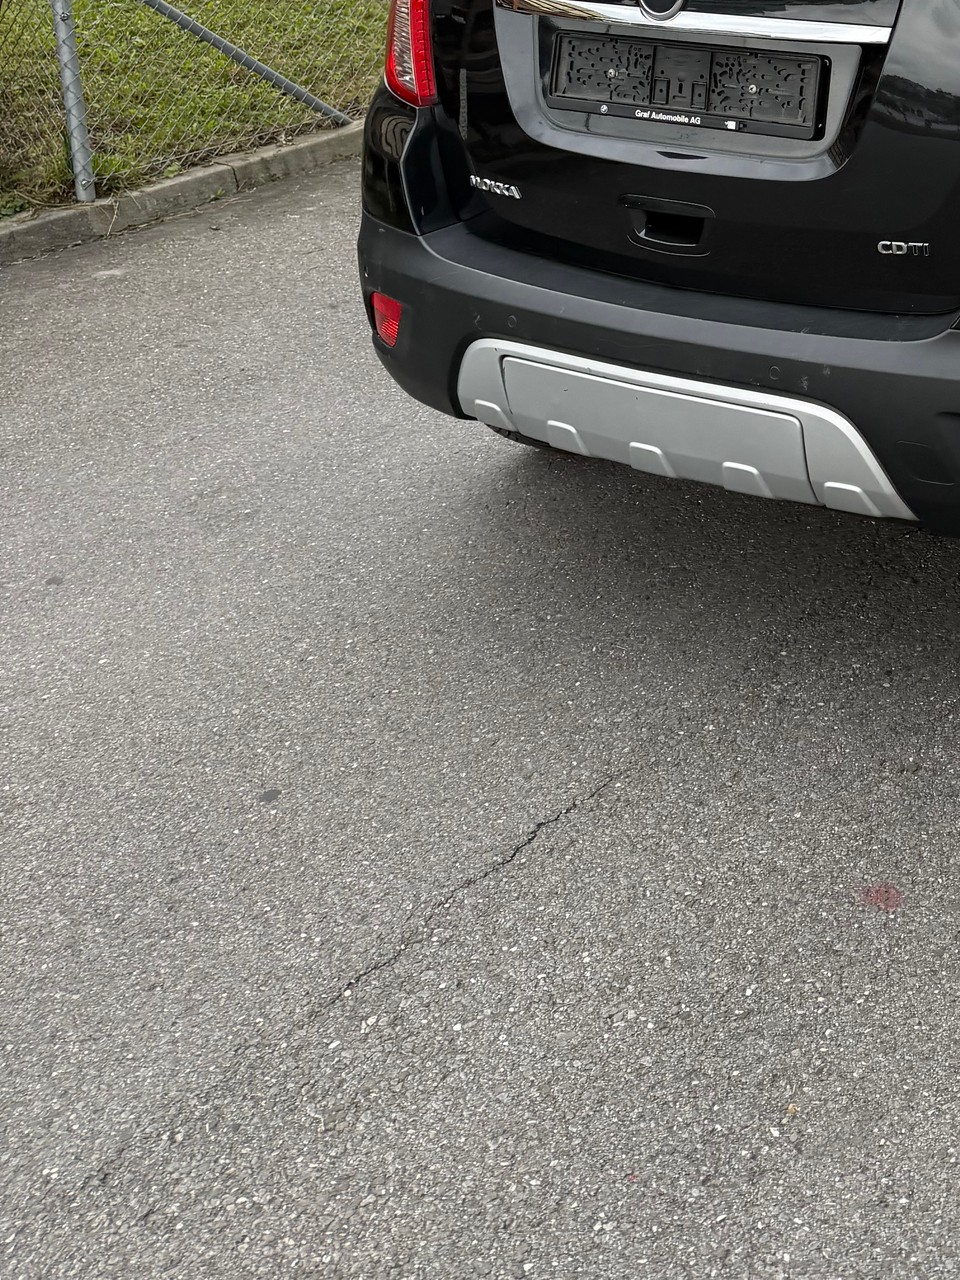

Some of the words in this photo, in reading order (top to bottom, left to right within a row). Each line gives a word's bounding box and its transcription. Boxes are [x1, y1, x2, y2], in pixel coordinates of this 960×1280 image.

[635, 109, 651, 119] Graf
[650, 111, 689, 123] Automobile
[689, 116, 701, 125] AG
[877, 240, 930, 257] CDTI
